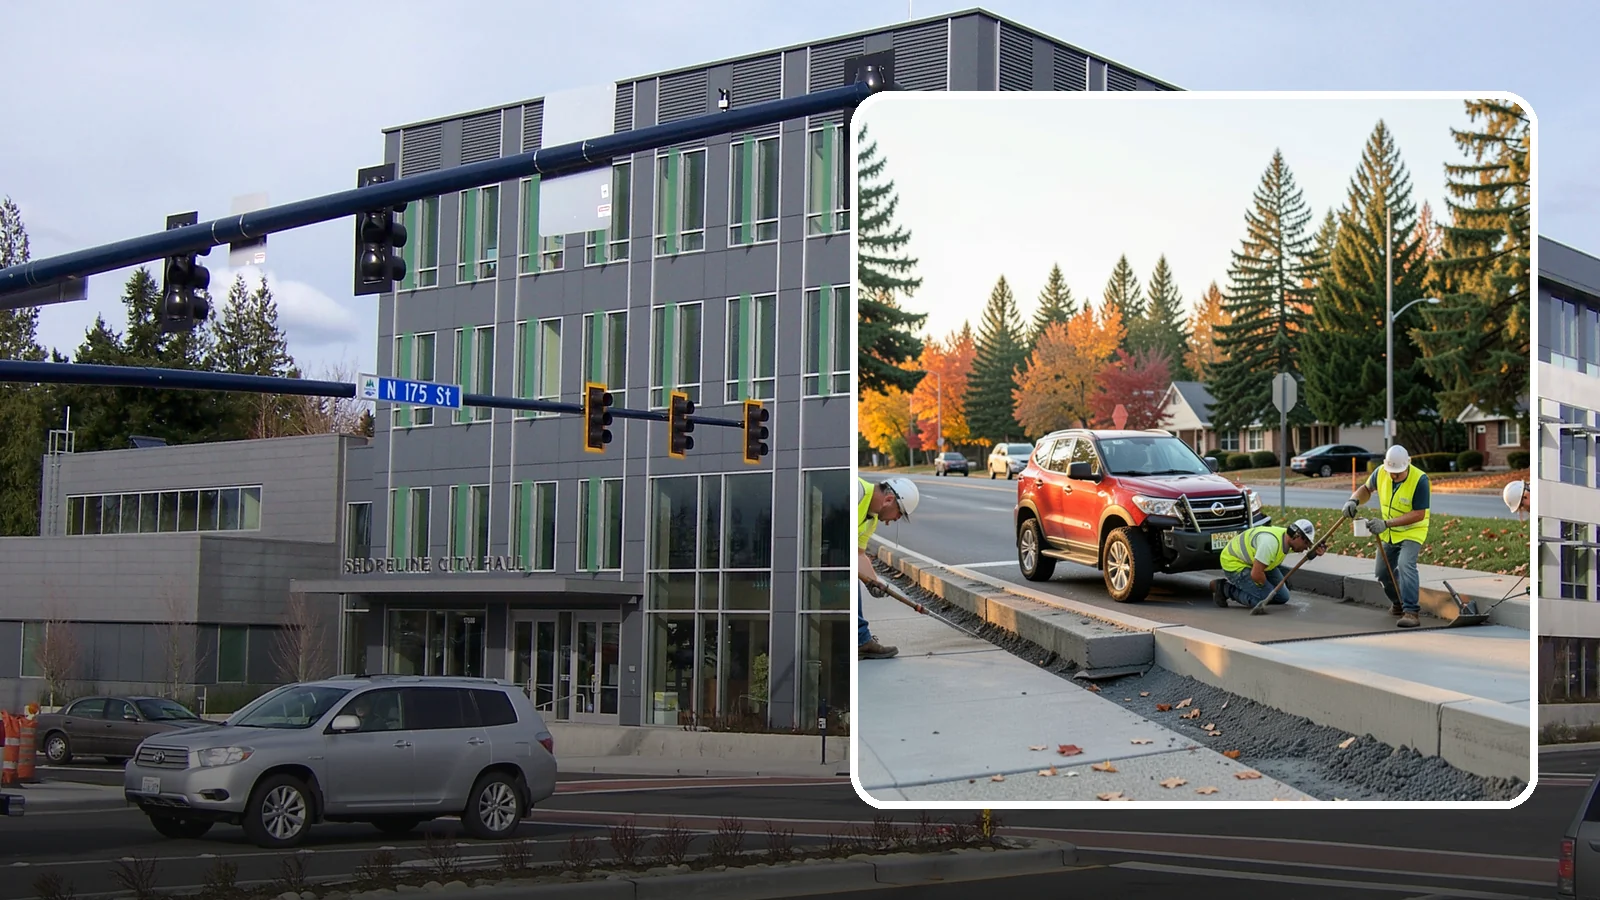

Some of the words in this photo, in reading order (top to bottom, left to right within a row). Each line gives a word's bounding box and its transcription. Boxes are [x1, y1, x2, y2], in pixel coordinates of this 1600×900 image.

[387, 380, 396, 400] N
[405, 382, 427, 403] 175
[436, 386, 451, 406] St
[344, 556, 432, 574] SHORELINE
[438, 556, 476, 573] CITY
[483, 555, 526, 573] HALL
